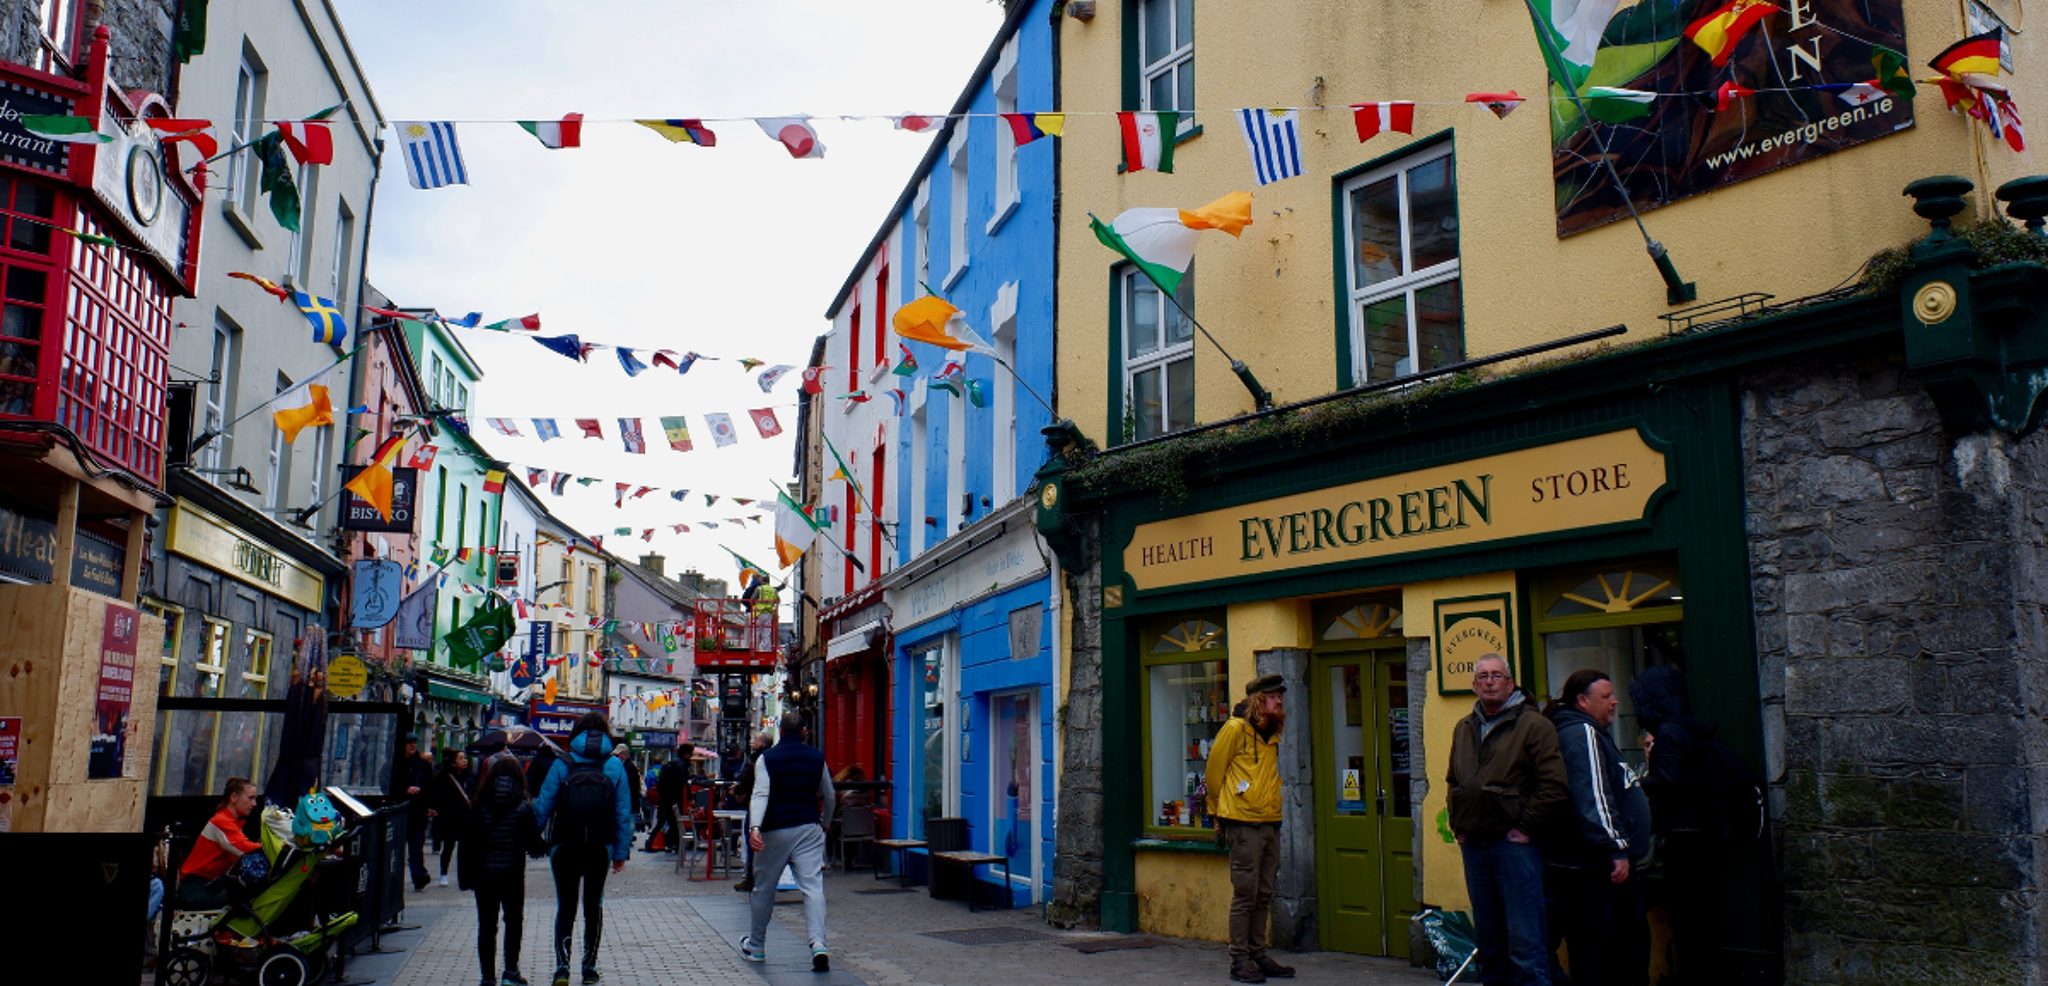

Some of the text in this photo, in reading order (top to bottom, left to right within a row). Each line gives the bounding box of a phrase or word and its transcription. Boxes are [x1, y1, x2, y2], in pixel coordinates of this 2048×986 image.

[1705, 97, 1894, 170] www.evergreen.ie
[1141, 463, 1631, 567] HEALTH EVERGREEN STORE
[534, 622, 547, 684] PORTWST
[1445, 627, 1503, 654] EVERGREEN
[1447, 661, 1475, 675] COR
